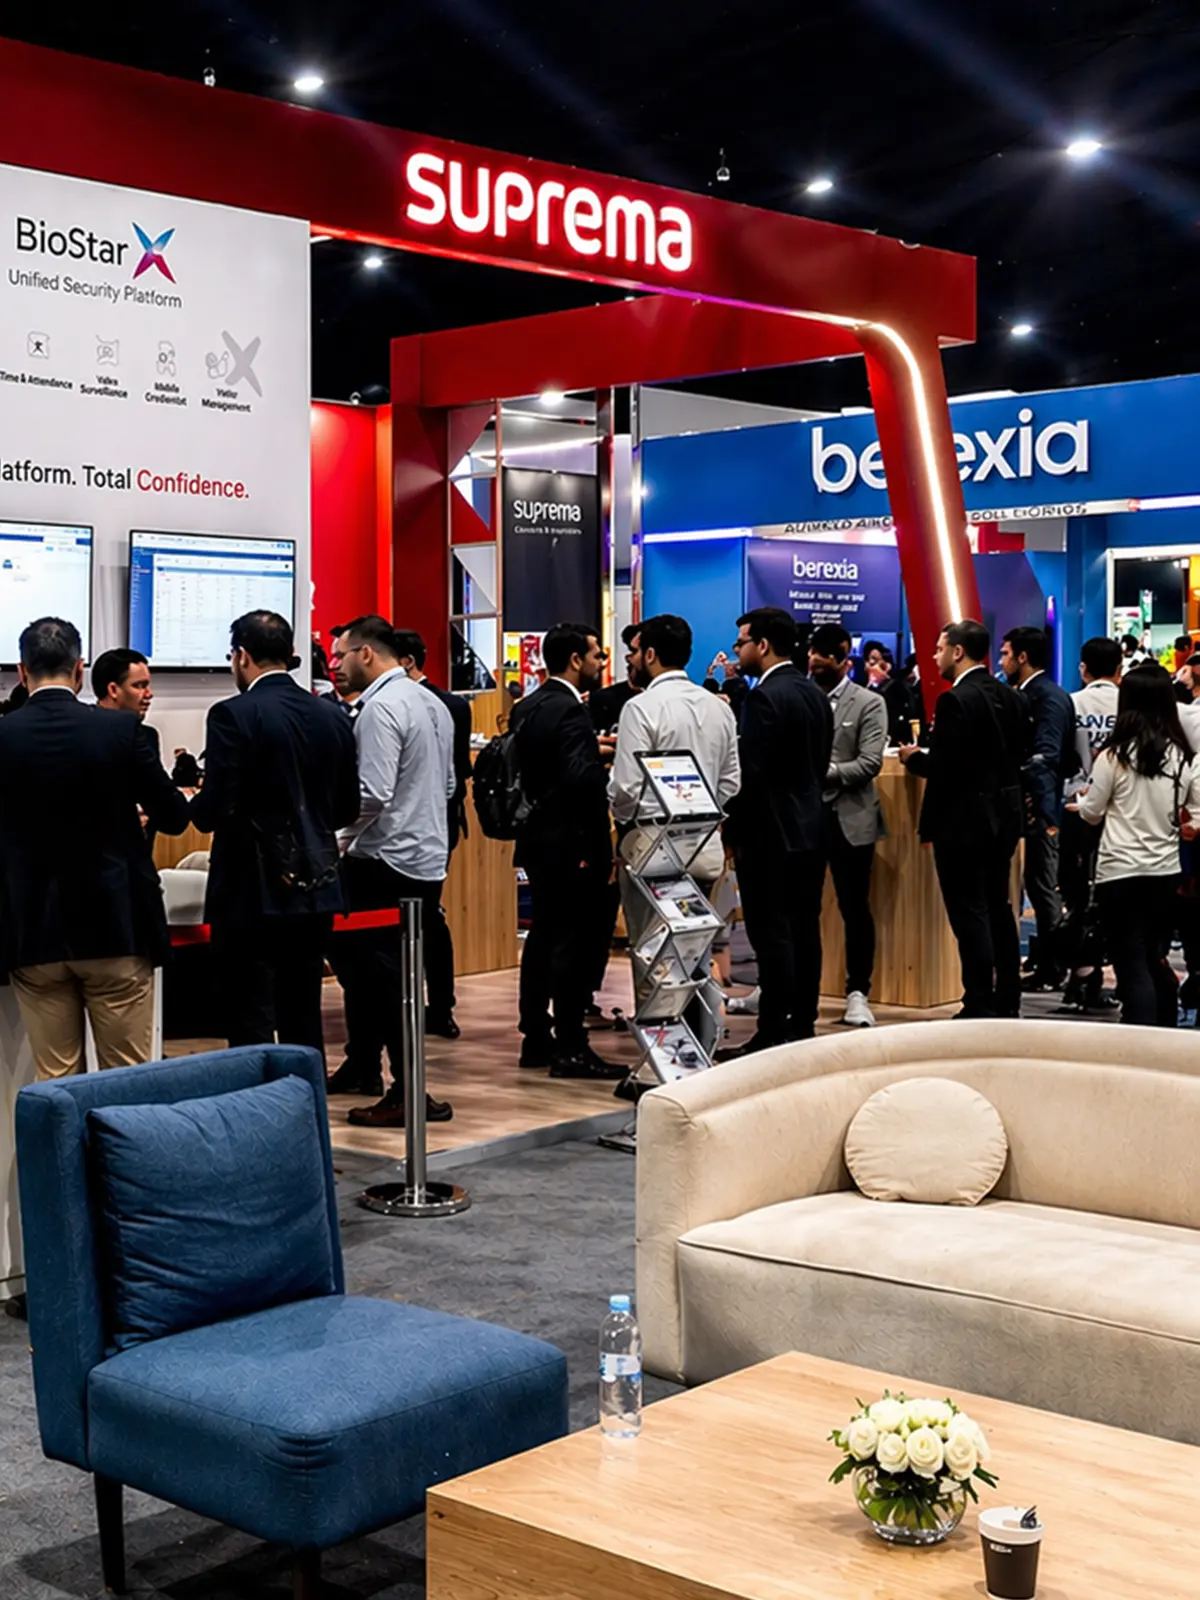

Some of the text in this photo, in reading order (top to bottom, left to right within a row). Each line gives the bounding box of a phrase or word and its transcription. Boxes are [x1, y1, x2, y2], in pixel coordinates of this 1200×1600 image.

[16, 217, 129, 266] BioStar
[8, 268, 182, 309] Unified Security Platform
[0, 370, 19, 384] Time
[82, 465, 131, 490] Total
[136, 469, 250, 499] Confidence.
[793, 554, 858, 580] berexia
